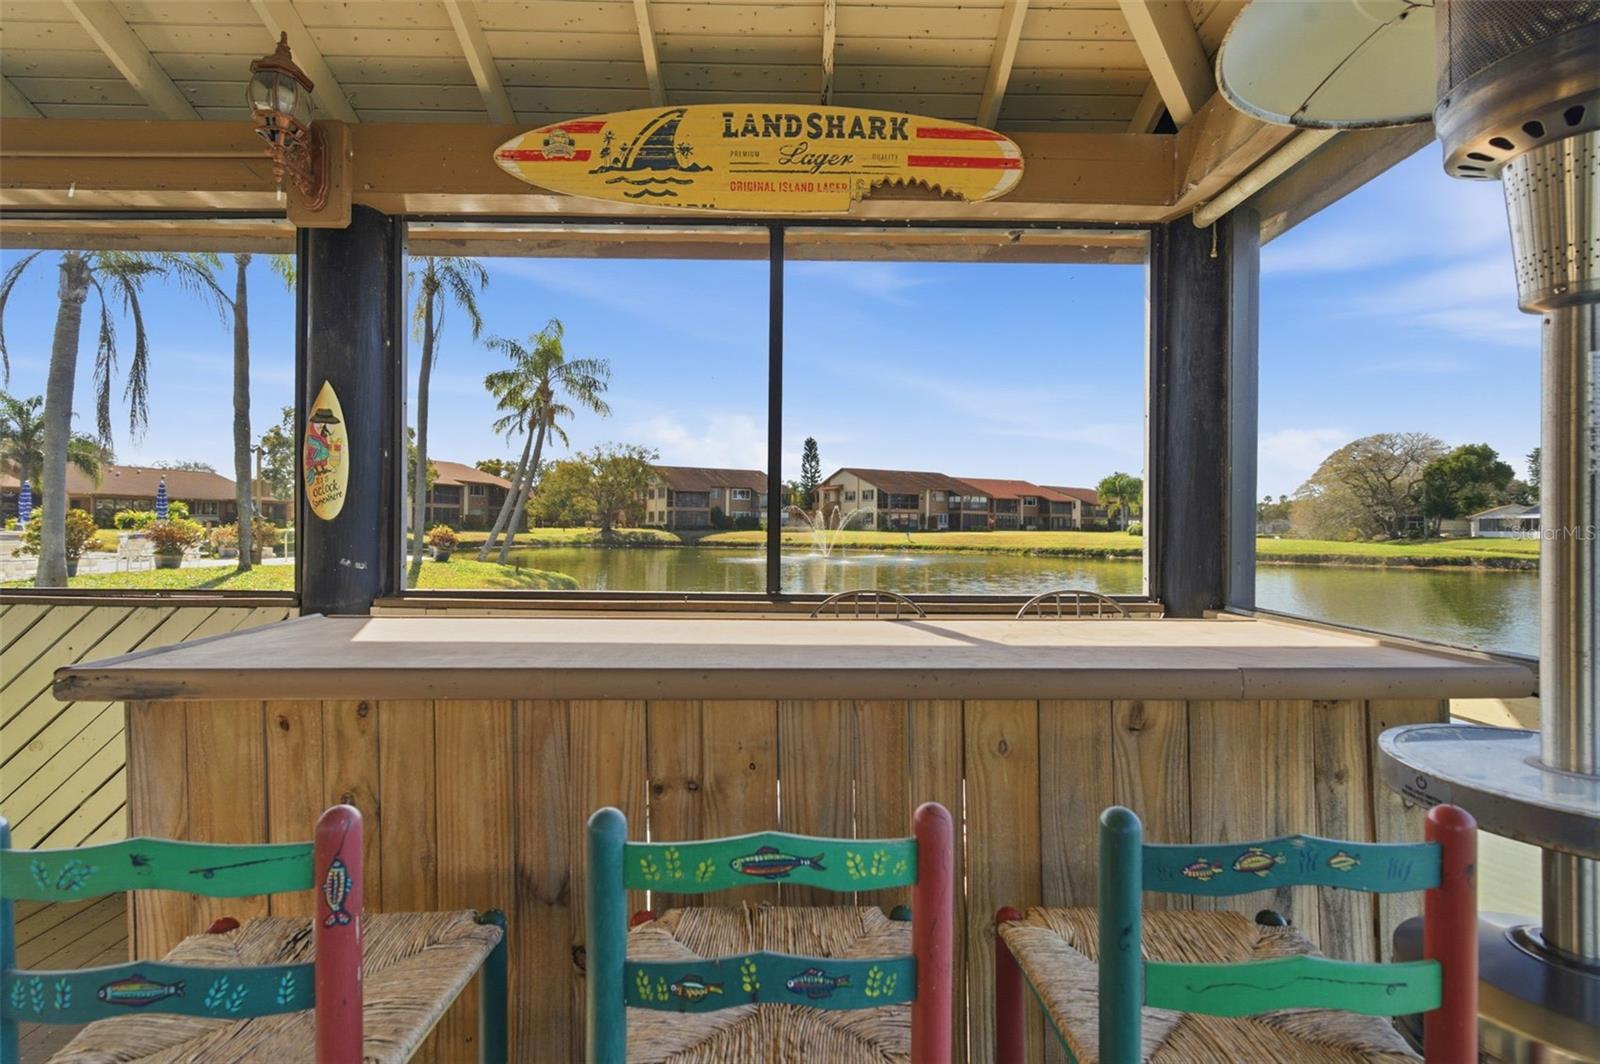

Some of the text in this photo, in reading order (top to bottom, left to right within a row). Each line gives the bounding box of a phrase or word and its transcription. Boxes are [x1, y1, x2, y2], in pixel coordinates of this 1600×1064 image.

[722, 111, 909, 141] LANDSHARK
[778, 141, 854, 174] Lager
[872, 153, 898, 161] QUALITY
[730, 181, 848, 193] ORIGINAL ISLAND LAGER
